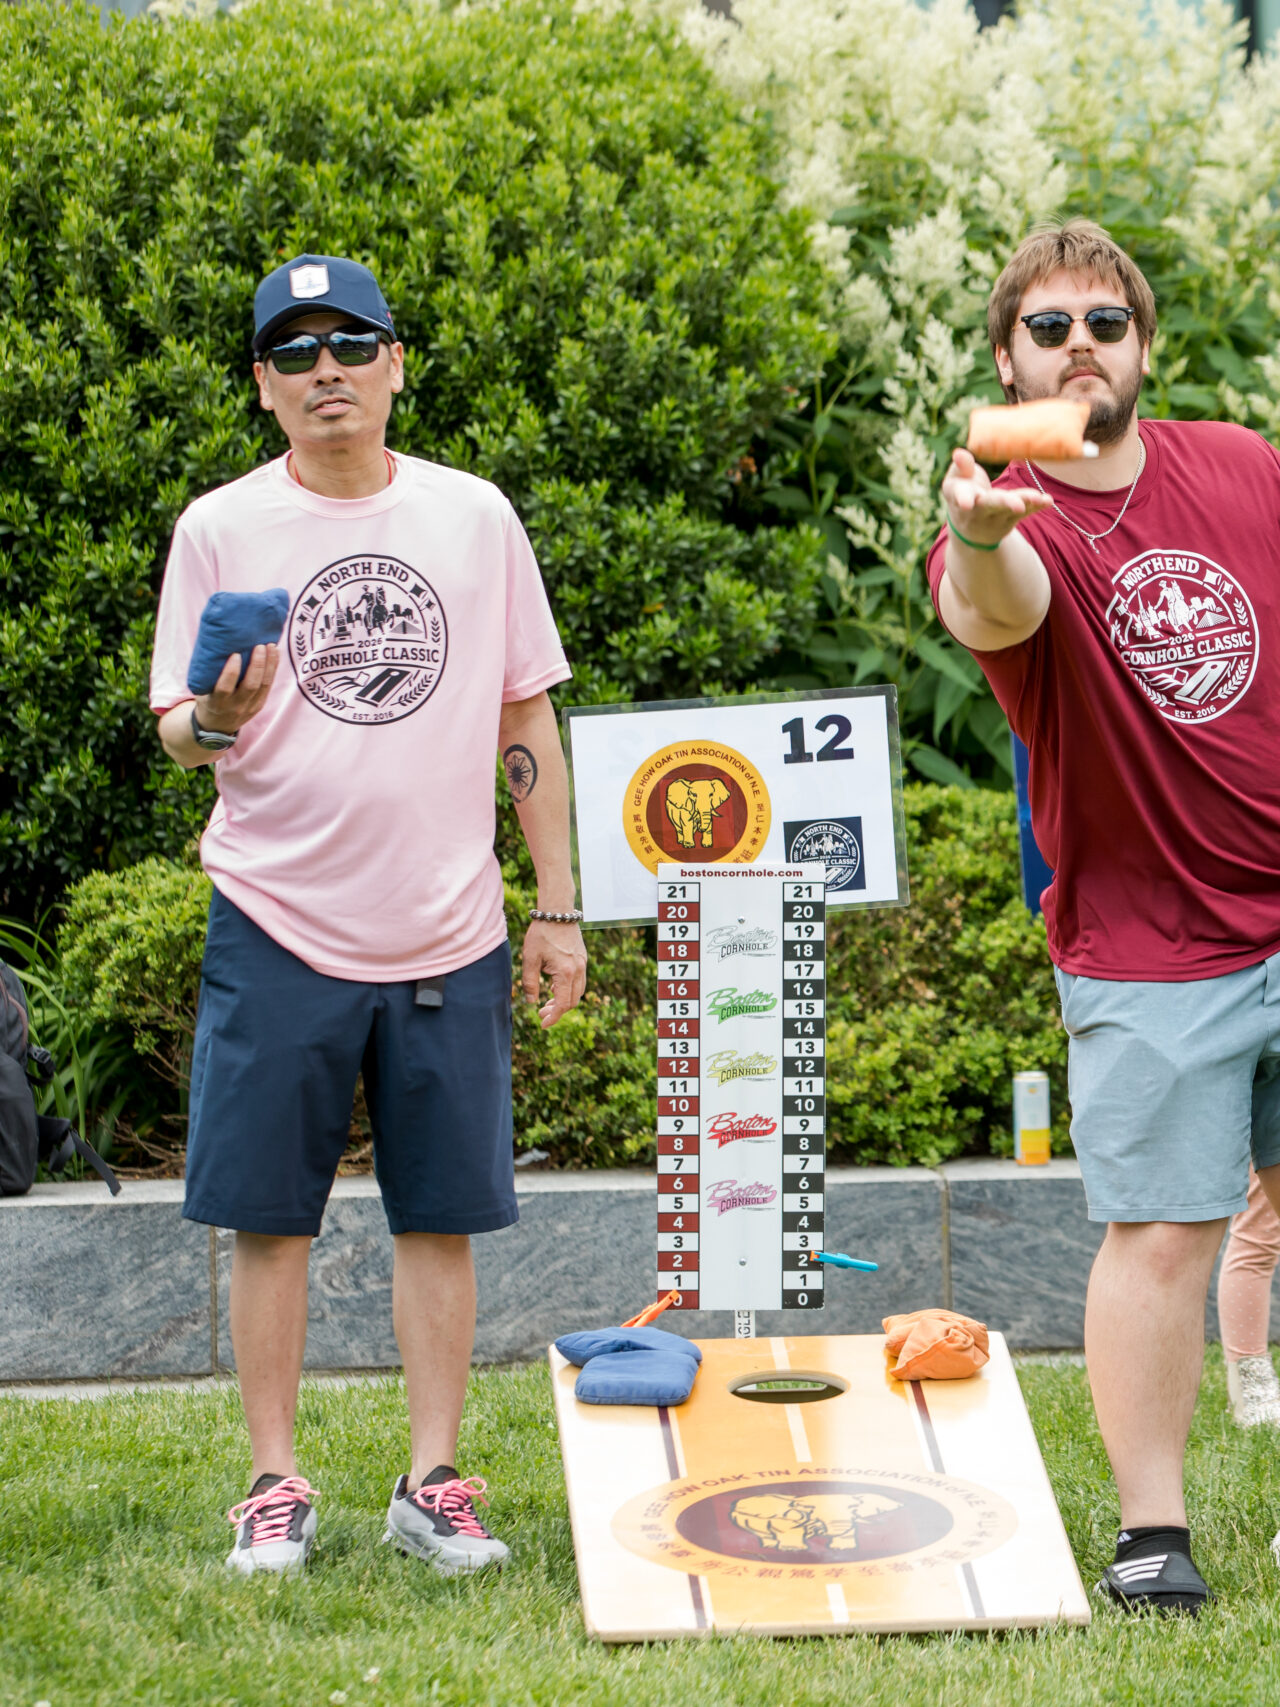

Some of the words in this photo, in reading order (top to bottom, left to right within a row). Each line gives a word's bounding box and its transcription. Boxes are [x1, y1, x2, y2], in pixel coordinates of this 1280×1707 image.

[318, 562, 372, 592] NORTH
[377, 562, 409, 583] END
[1121, 556, 1165, 591] NORTH
[1166, 557, 1200, 574] END
[1169, 633, 1195, 645] 2026
[1121, 645, 1196, 666] CORNHOLE
[1197, 631, 1252, 655] CLASSIC
[302, 649, 378, 674] CORNHOLE
[383, 647, 440, 663] CLASSIC
[1175, 710, 1195, 719] EST.
[1197, 705, 1217, 718] 2016
[781, 714, 854, 764] 12
[634, 787, 644, 806] GEE
[641, 766, 656, 787] HOW
[655, 754, 673, 769] OAK
[674, 748, 688, 759] TIN
[691, 747, 747, 773] ASSOCIATION
[745, 772, 754, 781] of
[804, 825, 828, 837] NORTH
[829, 825, 843, 835] END
[680, 868, 803, 878] bostoncornhole.com
[667, 885, 686, 898] 21
[793, 885, 811, 897] 21
[666, 905, 687, 918] 20
[792, 905, 813, 918] 20
[668, 925, 688, 937] 19
[794, 924, 814, 937] 19
[667, 944, 687, 957] 18
[720, 943, 769, 958] CORNHOLE
[793, 943, 813, 956] 18
[668, 964, 688, 976] 17
[794, 963, 814, 976] 17
[667, 983, 687, 995] 16
[793, 982, 813, 995] 16
[669, 1002, 688, 1015] 15
[720, 1005, 769, 1020] CORNHOLE
[795, 1002, 814, 1015] 15
[668, 1021, 688, 1034] 14
[794, 1021, 814, 1034] 14
[669, 1041, 688, 1054] 13
[795, 1041, 814, 1053] 13
[668, 1060, 688, 1073] 12
[794, 1059, 814, 1072] 12
[720, 1067, 769, 1083] CORNHOLE
[669, 1080, 687, 1092] 11
[794, 1080, 812, 1092] 11
[668, 1098, 689, 1111] 10
[794, 1098, 814, 1111] 10
[673, 1119, 683, 1131] 9
[705, 1112, 775, 1133] Boston
[799, 1118, 809, 1131] 9
[673, 1137, 683, 1150] 8
[799, 1137, 809, 1150] 8
[673, 1157, 683, 1170] 7
[799, 1157, 809, 1170] 7
[673, 1177, 683, 1190] 6
[798, 1176, 809, 1189] 6
[705, 1179, 775, 1202] Boston
[673, 1196, 683, 1209] 5
[720, 1197, 769, 1212] CORNHOLE
[799, 1196, 808, 1208] 5
[672, 1215, 683, 1228] 4
[798, 1215, 809, 1228] 4
[673, 1235, 683, 1248] 3
[799, 1234, 808, 1247] 3
[672, 1254, 682, 1267] 2
[798, 1253, 808, 1266] 2
[674, 1274, 681, 1286] 1
[799, 1273, 806, 1286] 1
[797, 1292, 808, 1305] 0
[701, 1474, 751, 1486] OAK
[752, 1469, 791, 1478] TIN
[798, 1467, 948, 1488] ASSOCIATION
